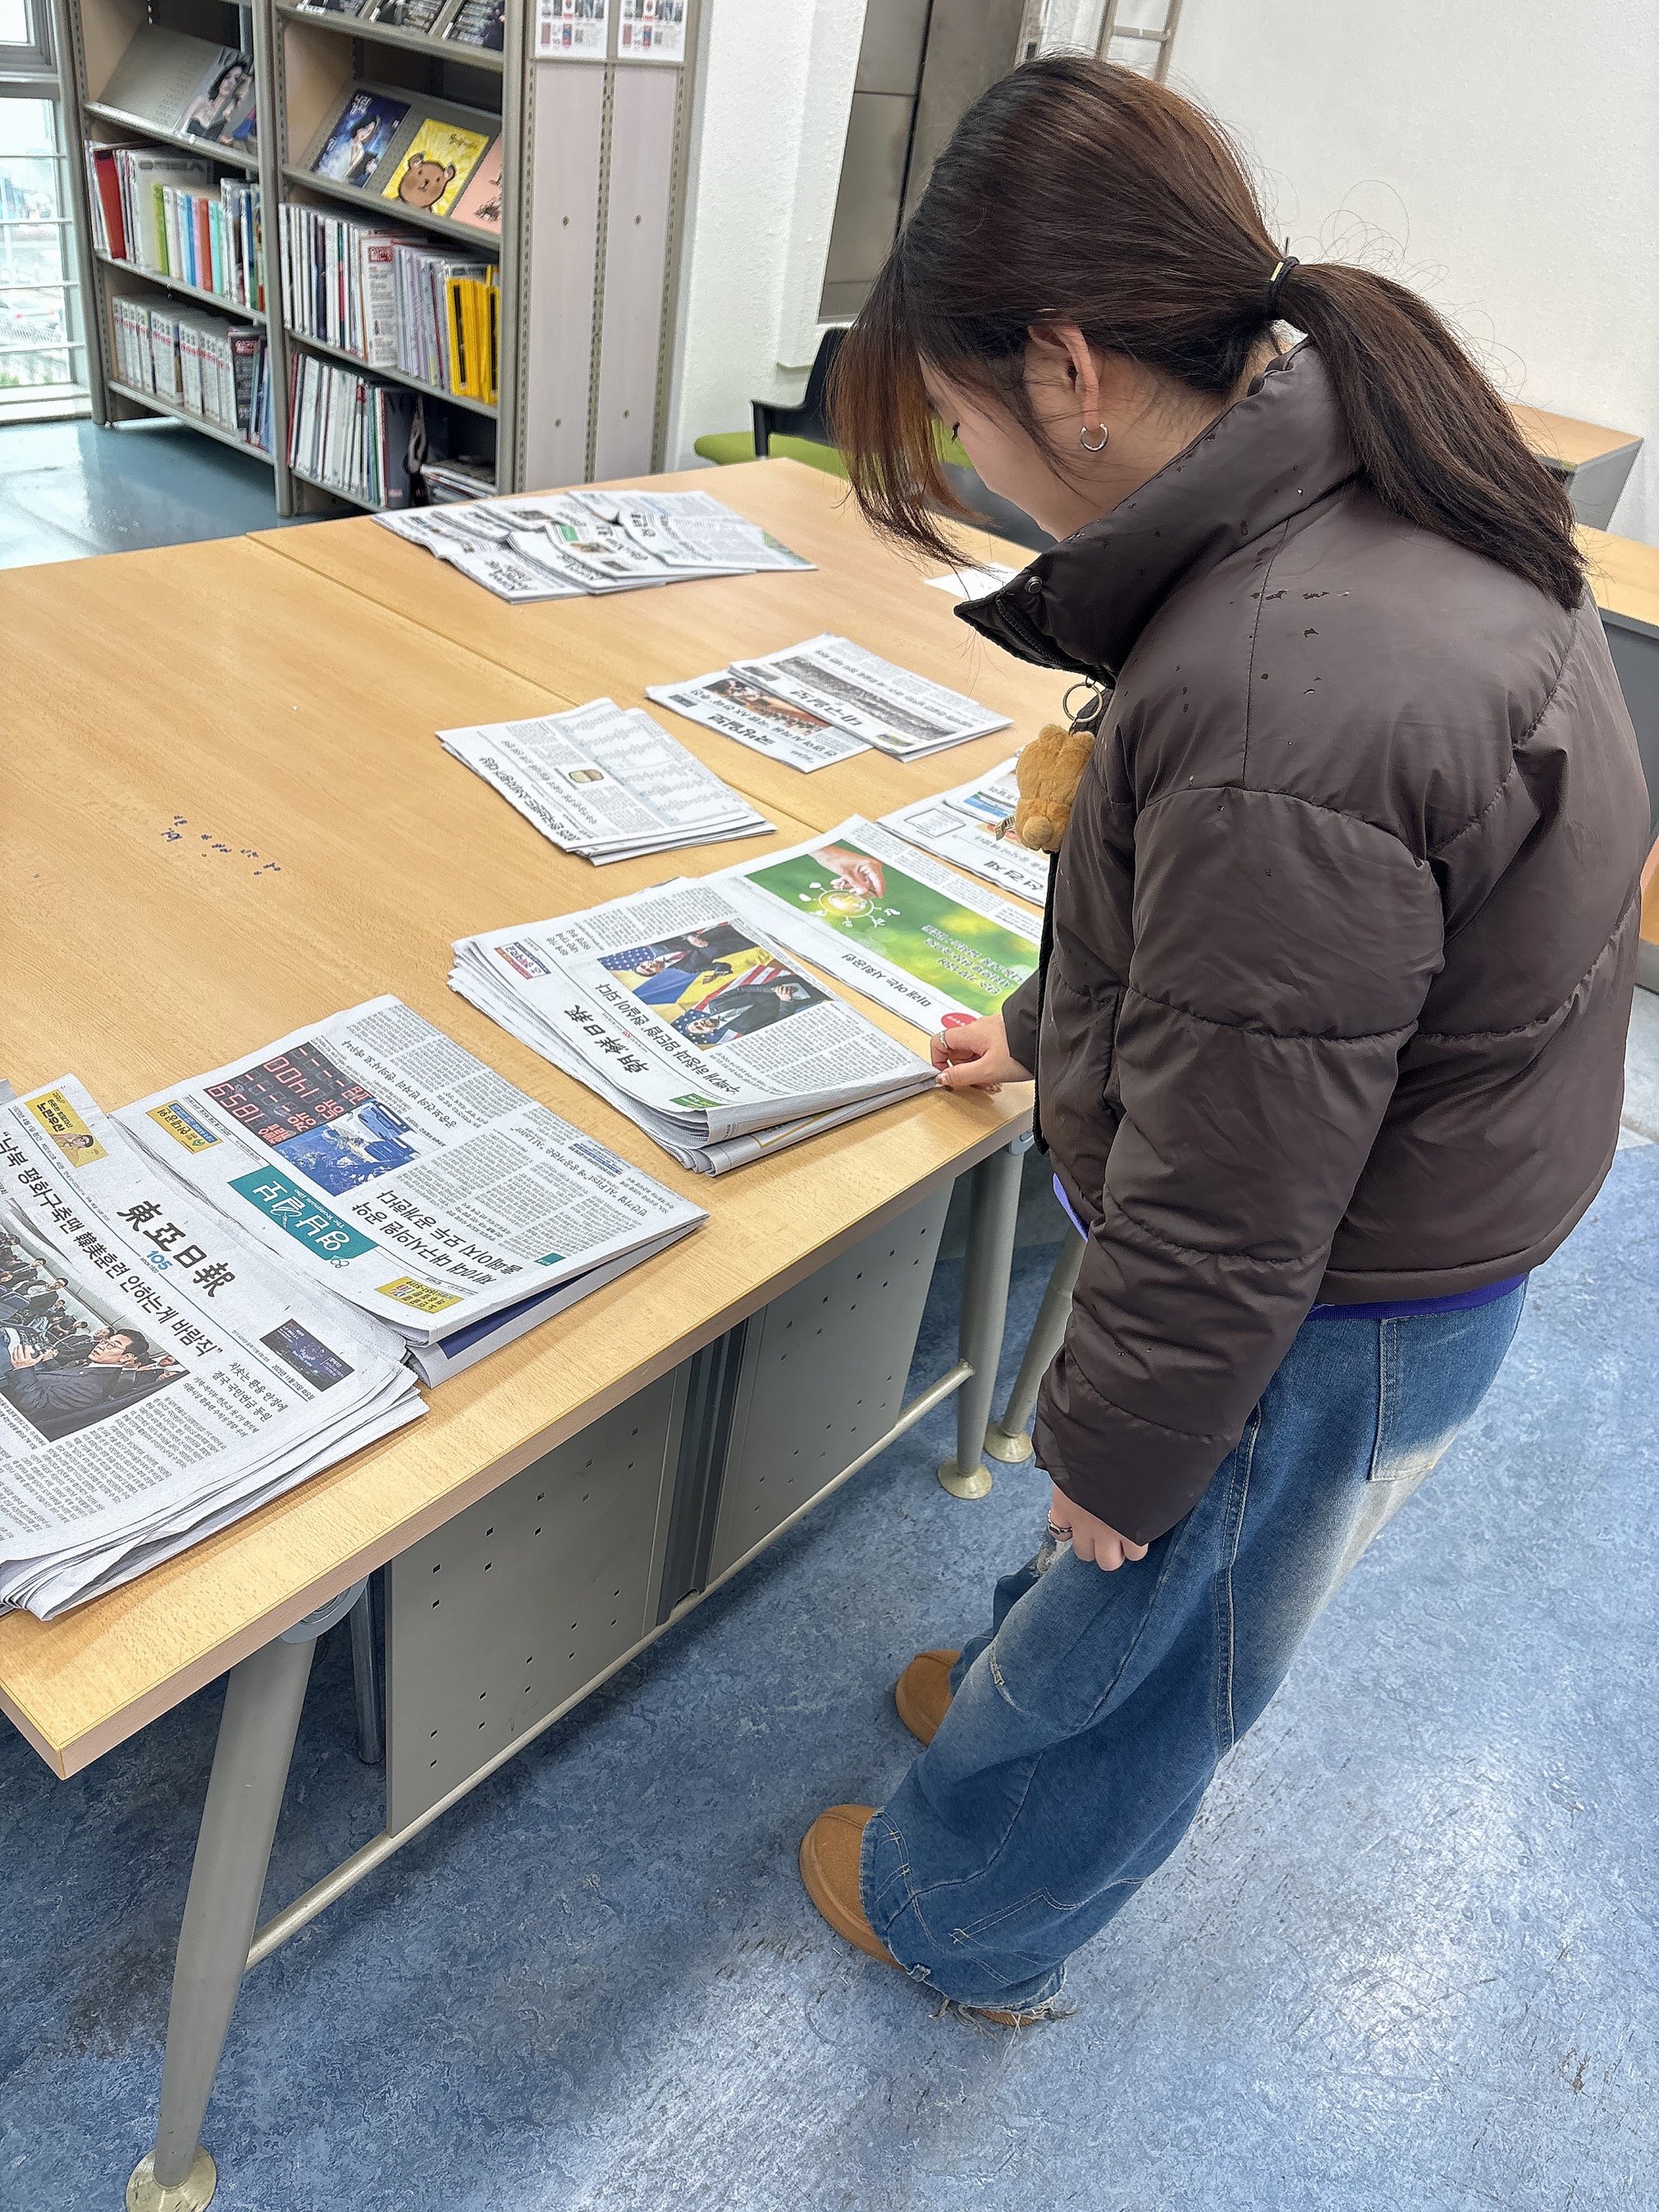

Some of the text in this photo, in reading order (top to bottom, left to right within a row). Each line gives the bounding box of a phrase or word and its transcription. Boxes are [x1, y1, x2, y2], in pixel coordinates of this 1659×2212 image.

[596, 984, 621, 1001] 되다
[841, 952, 932, 1007] 미래 여는 사회공헌
[614, 1001, 649, 1026] 현실이
[563, 1004, 650, 1074] 朝鮮日報
[673, 1050, 709, 1074] 하청과
[208, 1081, 266, 1123] 1859
[260, 1057, 344, 1118] 등유 1400
[341, 1086, 372, 1105] 고급
[396, 1080, 420, 1099] 빈자리
[36, 1103, 66, 1132] 노란우산
[157, 1108, 191, 1134] 현대공원
[287, 1113, 319, 1132] 경유
[417, 1098, 456, 1128] 공중보건의
[252, 1181, 349, 1250] 영남일보
[377, 1190, 436, 1229] 공개한다
[617, 1196, 647, 1216] 민간기업
[333, 1220, 344, 1228] The
[431, 1228, 466, 1247] 모두
[117, 1201, 235, 1297] 東亞日報
[352, 1202, 496, 1284] 제10대 대구시의원 공약
[17, 1167, 85, 1235] 평화구축땐
[73, 1232, 130, 1279] 韓美훈련
[119, 1276, 179, 1323] 안하는게
[171, 1319, 223, 1357] 바람직”
[147, 1251, 173, 1269] 105
[212, 1371, 272, 1422] 결국 국민연금 동원
[229, 1362, 288, 1412] 치솟는 환율 안정에
[293, 1381, 304, 1391] 25일
[301, 1389, 315, 1401] 화요일
